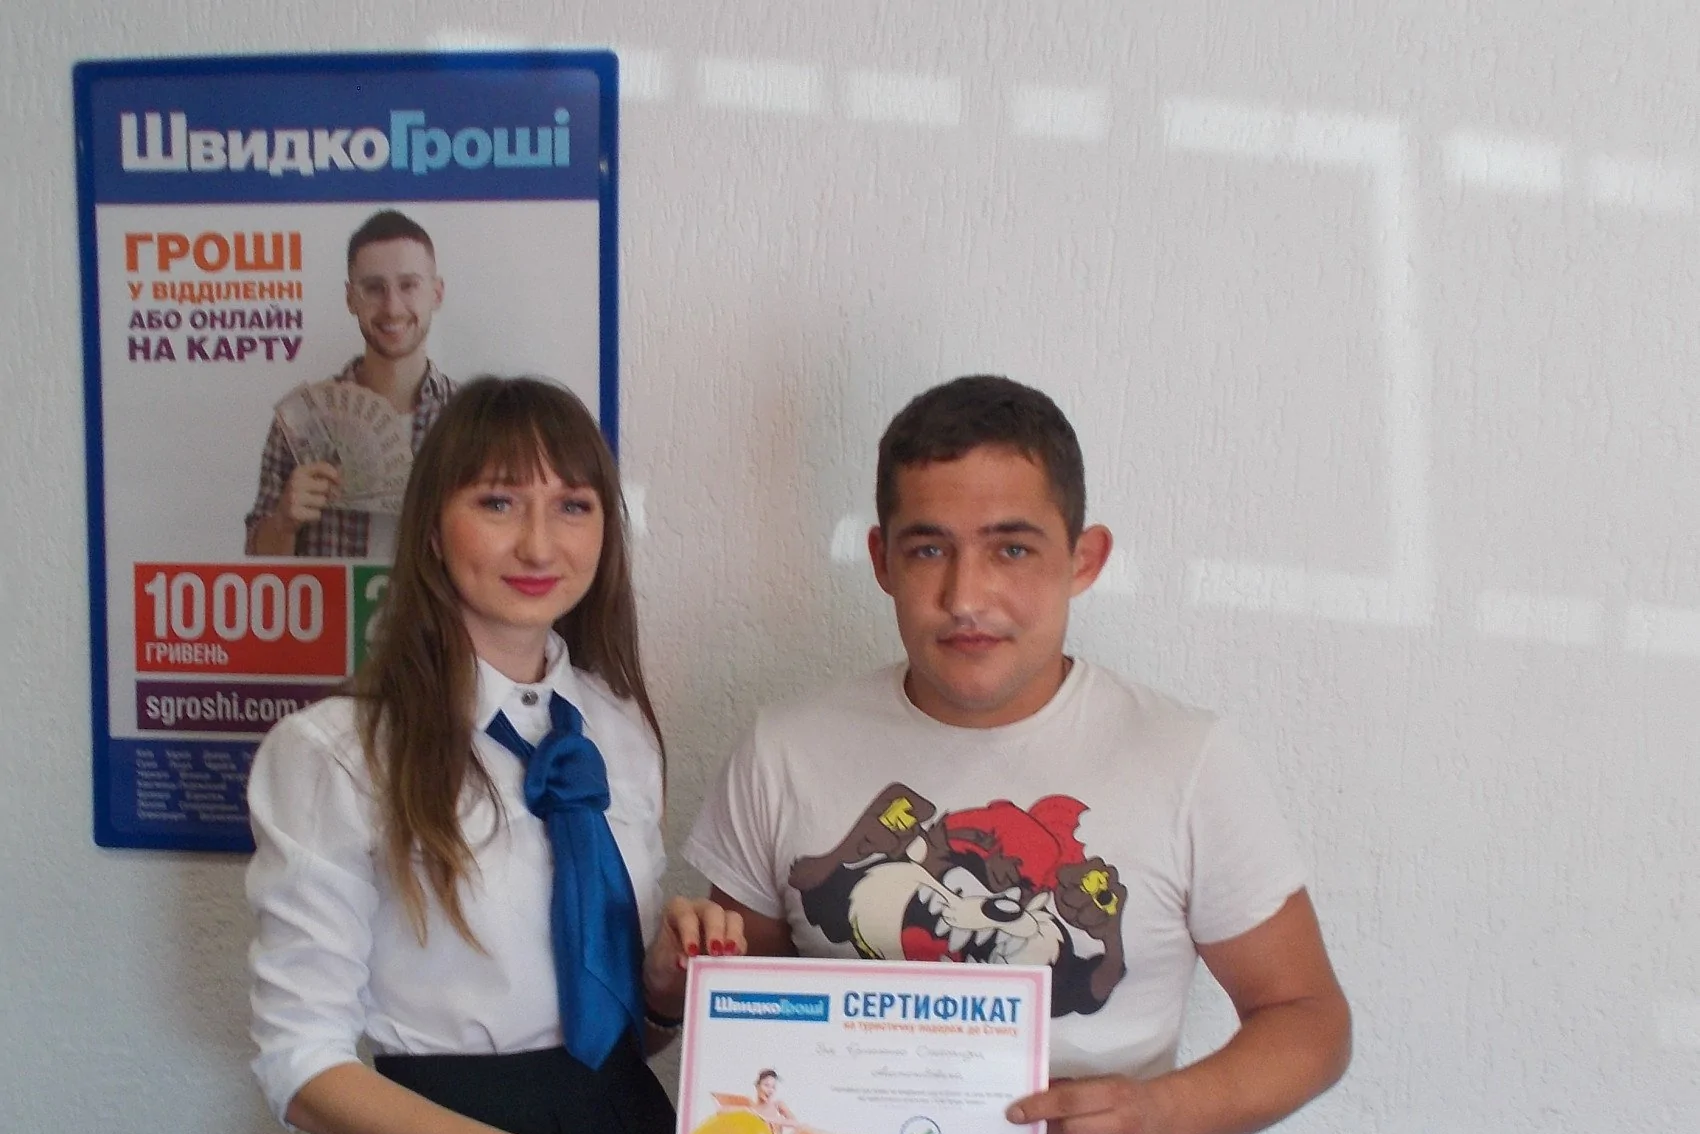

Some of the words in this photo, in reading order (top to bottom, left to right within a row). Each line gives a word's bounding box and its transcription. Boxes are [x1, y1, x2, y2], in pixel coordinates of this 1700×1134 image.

[120, 107, 571, 176] ШвидкоГроші
[125, 231, 303, 273] ГРОШІ
[128, 280, 144, 301] У
[151, 280, 303, 305] ВІДДІЛЕННІ
[129, 309, 183, 330] АБО
[189, 302, 303, 330] ОНЛАЙН
[128, 335, 176, 362] НА
[186, 335, 303, 362] КАРТУ
[145, 642, 229, 666] ГРИВЕНЬ
[146, 691, 307, 727] sgroshi.com
[843, 991, 1022, 1023] СЕРТИФІКАТ
